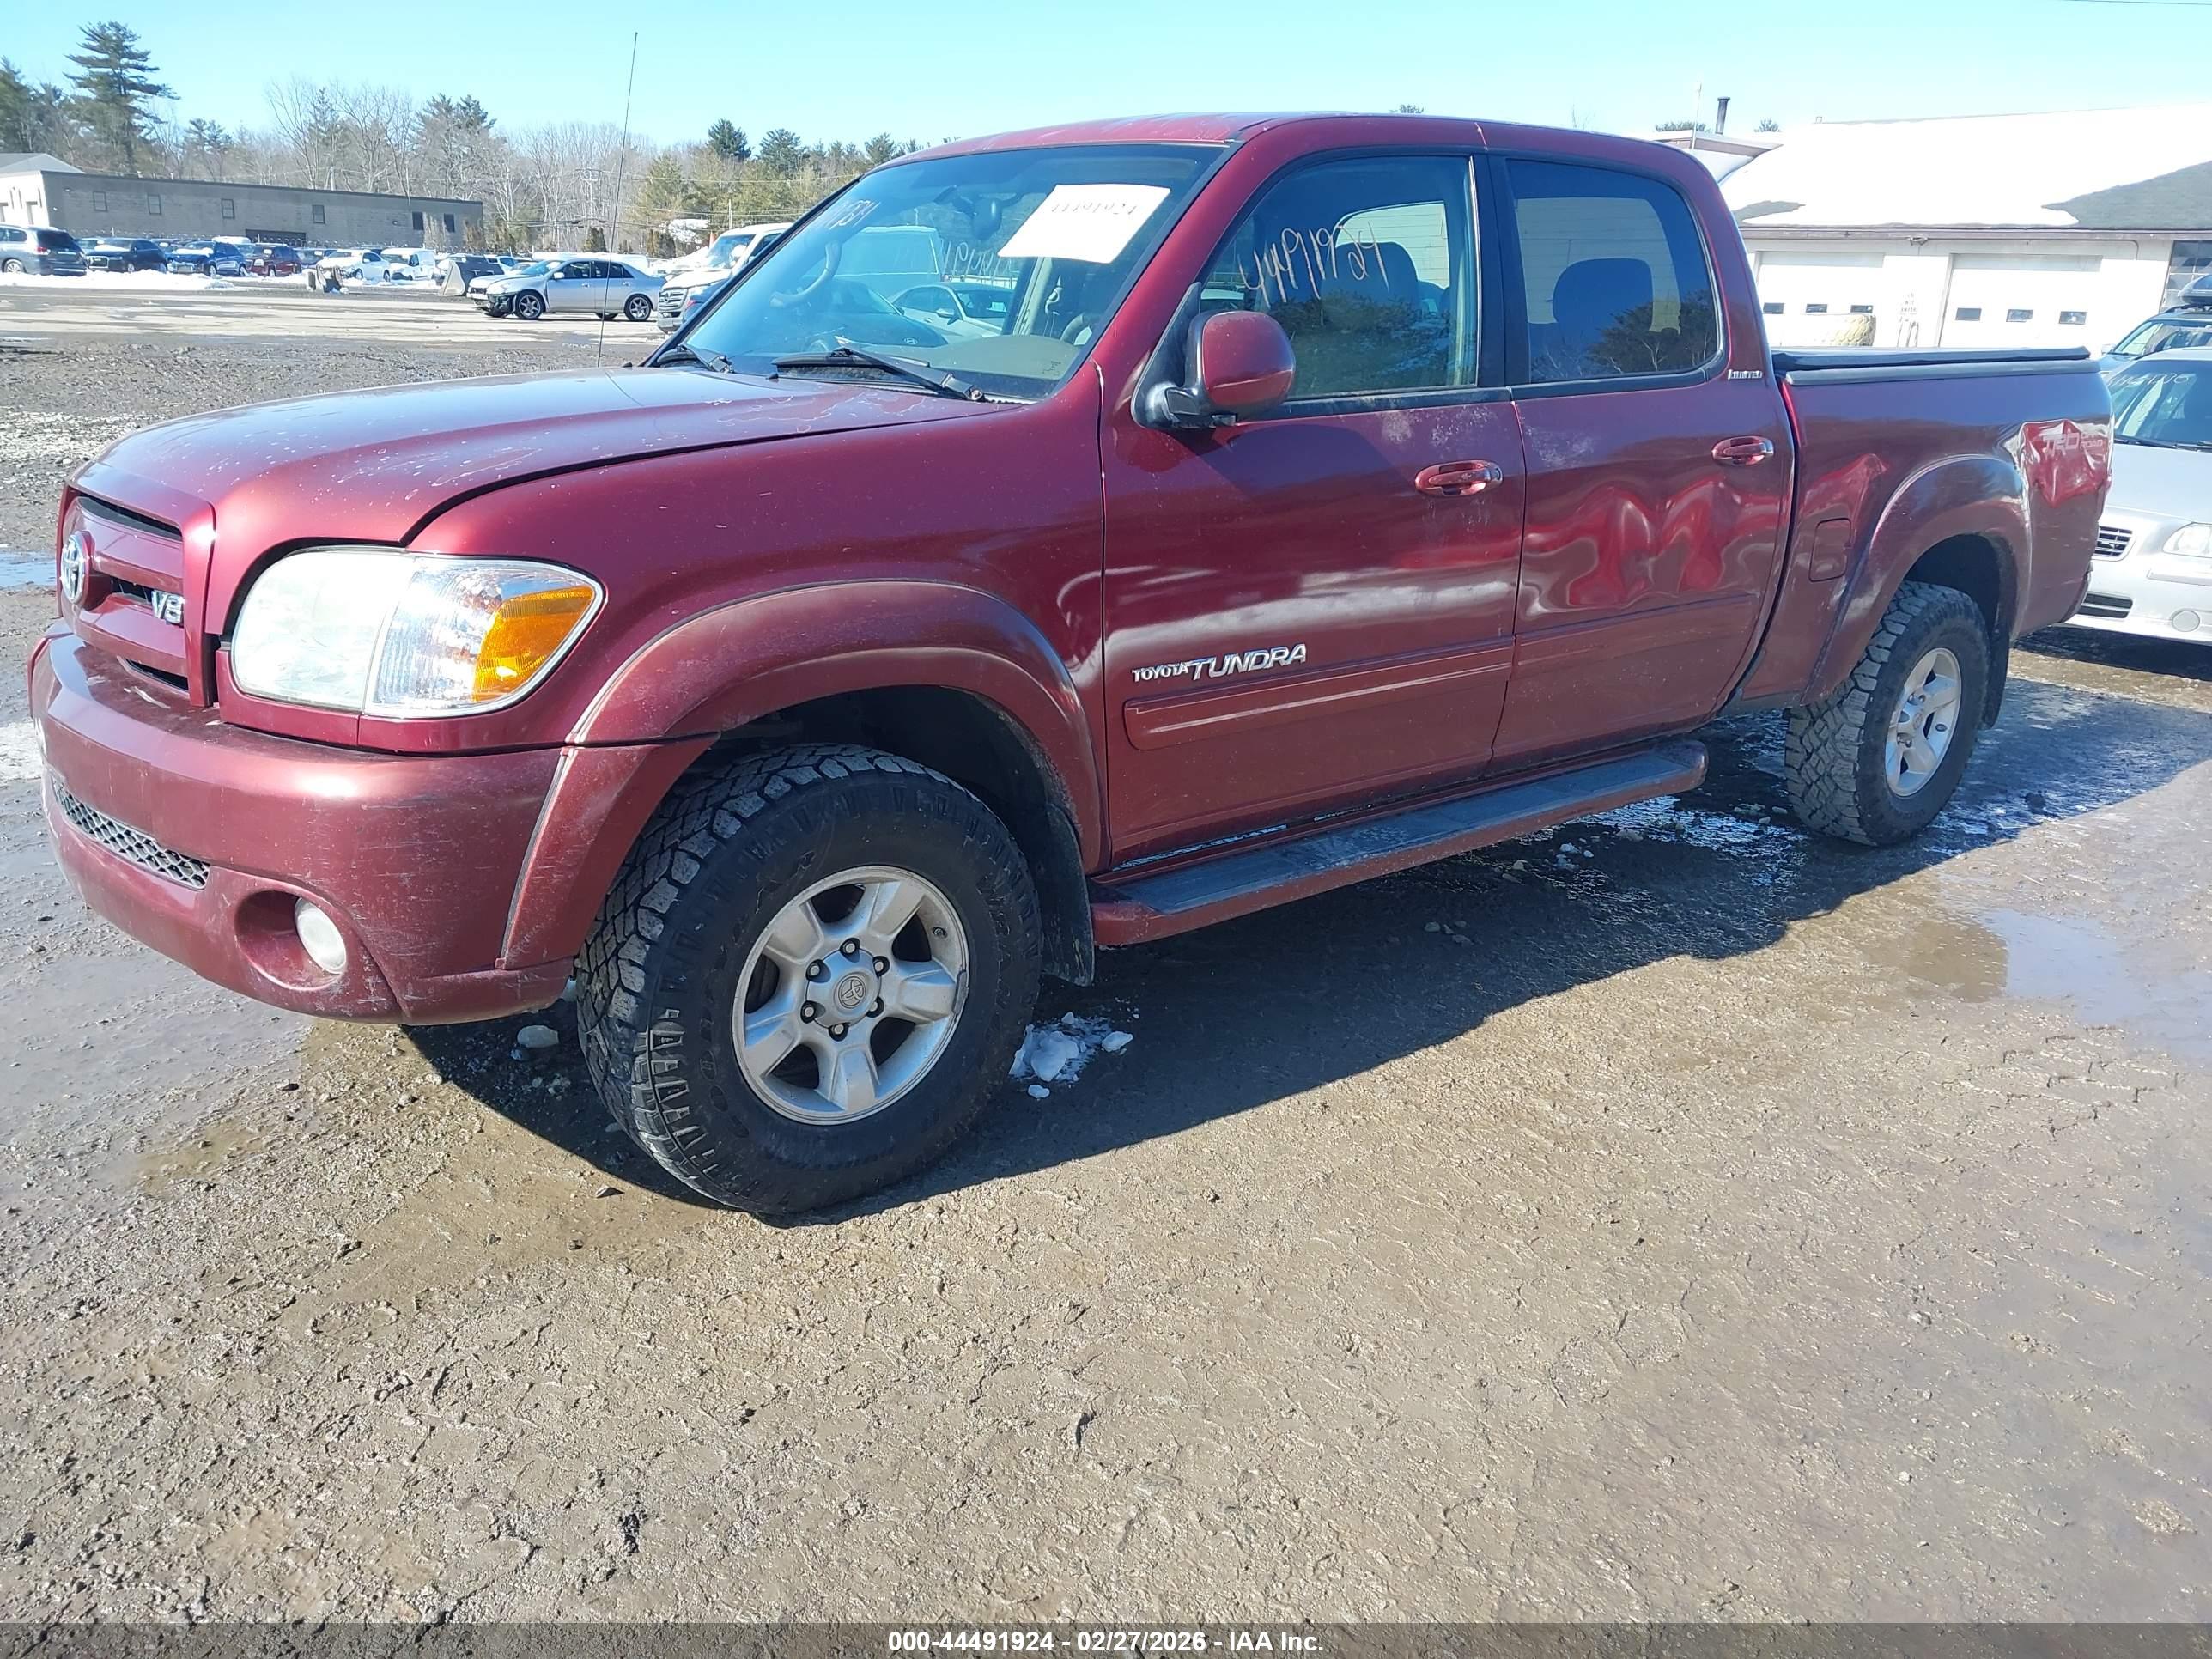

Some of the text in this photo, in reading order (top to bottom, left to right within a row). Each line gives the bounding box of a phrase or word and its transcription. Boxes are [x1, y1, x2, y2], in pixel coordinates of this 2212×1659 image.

[1237, 221, 1389, 309] 44491924
[2042, 432, 2080, 457] TRD
[150, 589, 185, 623] V8
[1132, 643, 1307, 683] TOYOTA TUNDRA
